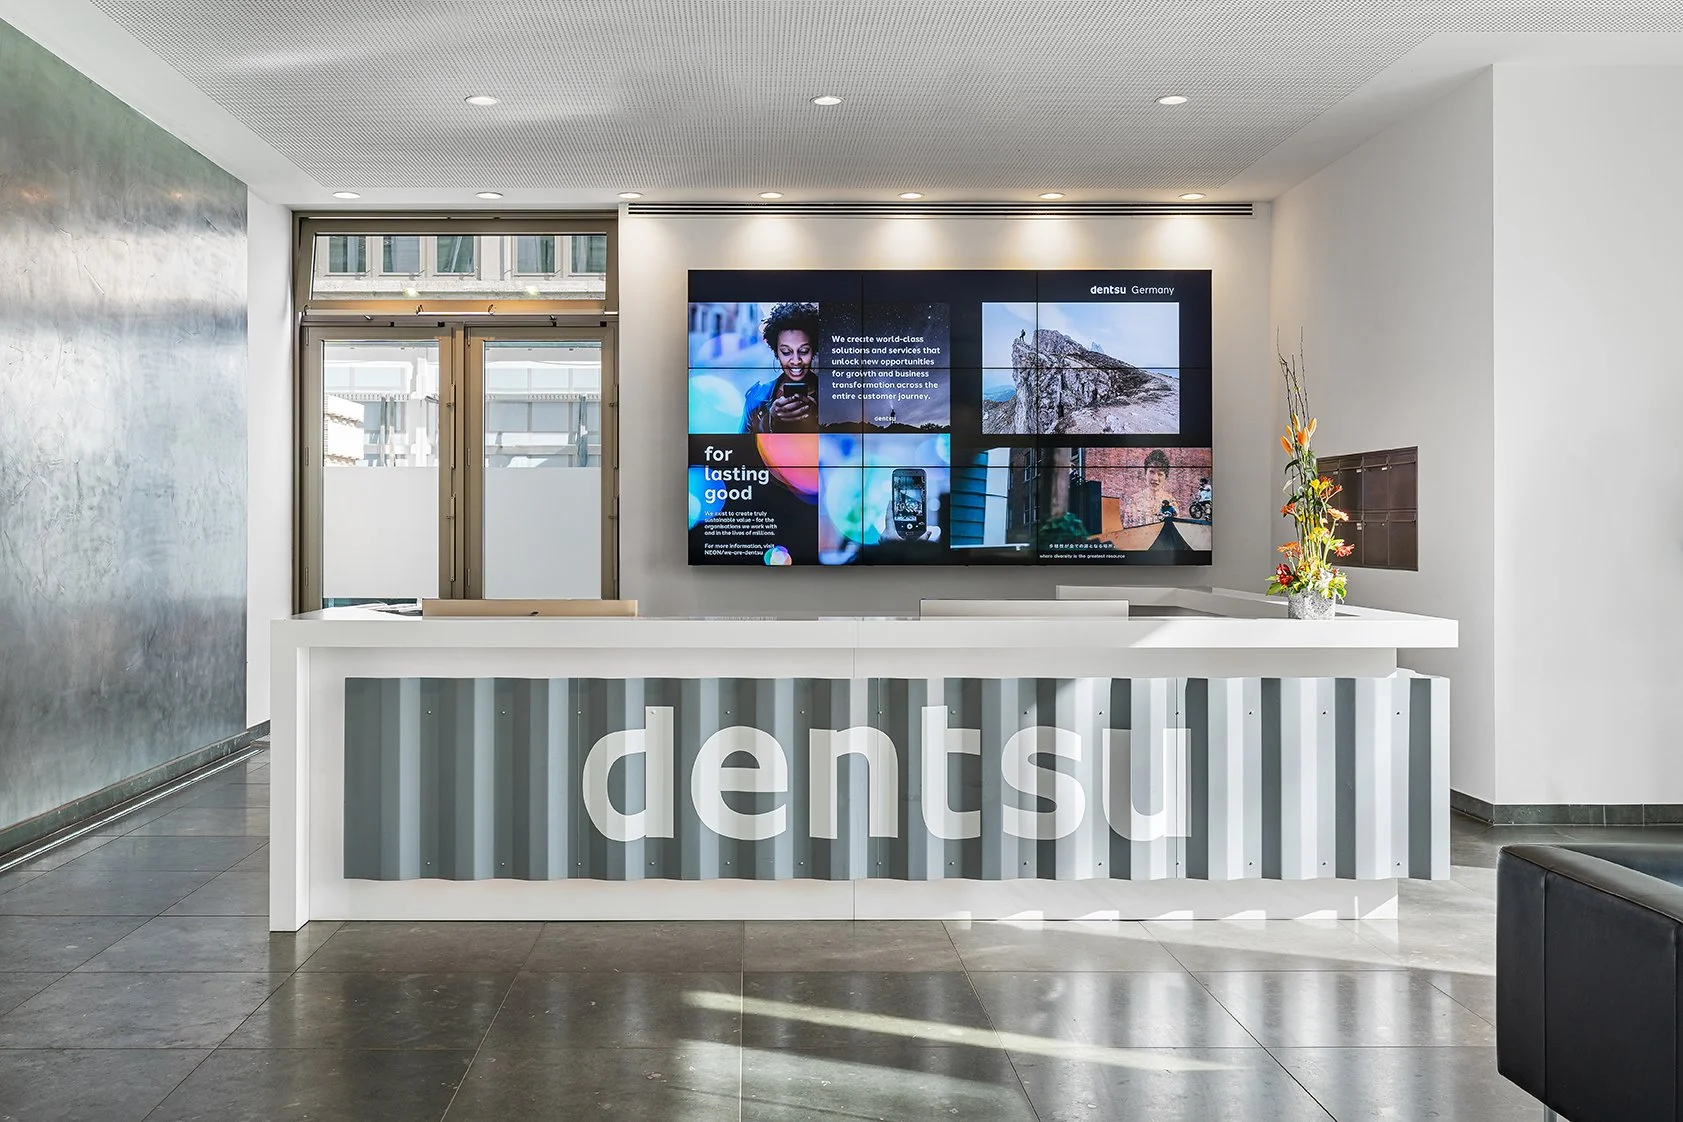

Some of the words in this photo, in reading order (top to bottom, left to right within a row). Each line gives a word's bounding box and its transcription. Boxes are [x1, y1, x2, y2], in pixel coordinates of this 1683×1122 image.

[1090, 285, 1127, 294] dentsu
[1131, 286, 1174, 296] Germany
[880, 358, 935, 366] opportunities
[846, 370, 876, 378] growth
[898, 393, 930, 401] journey.
[704, 446, 733, 461] for
[705, 465, 769, 485] lasting
[705, 486, 752, 504] good
[582, 706, 1192, 842] dentsu
